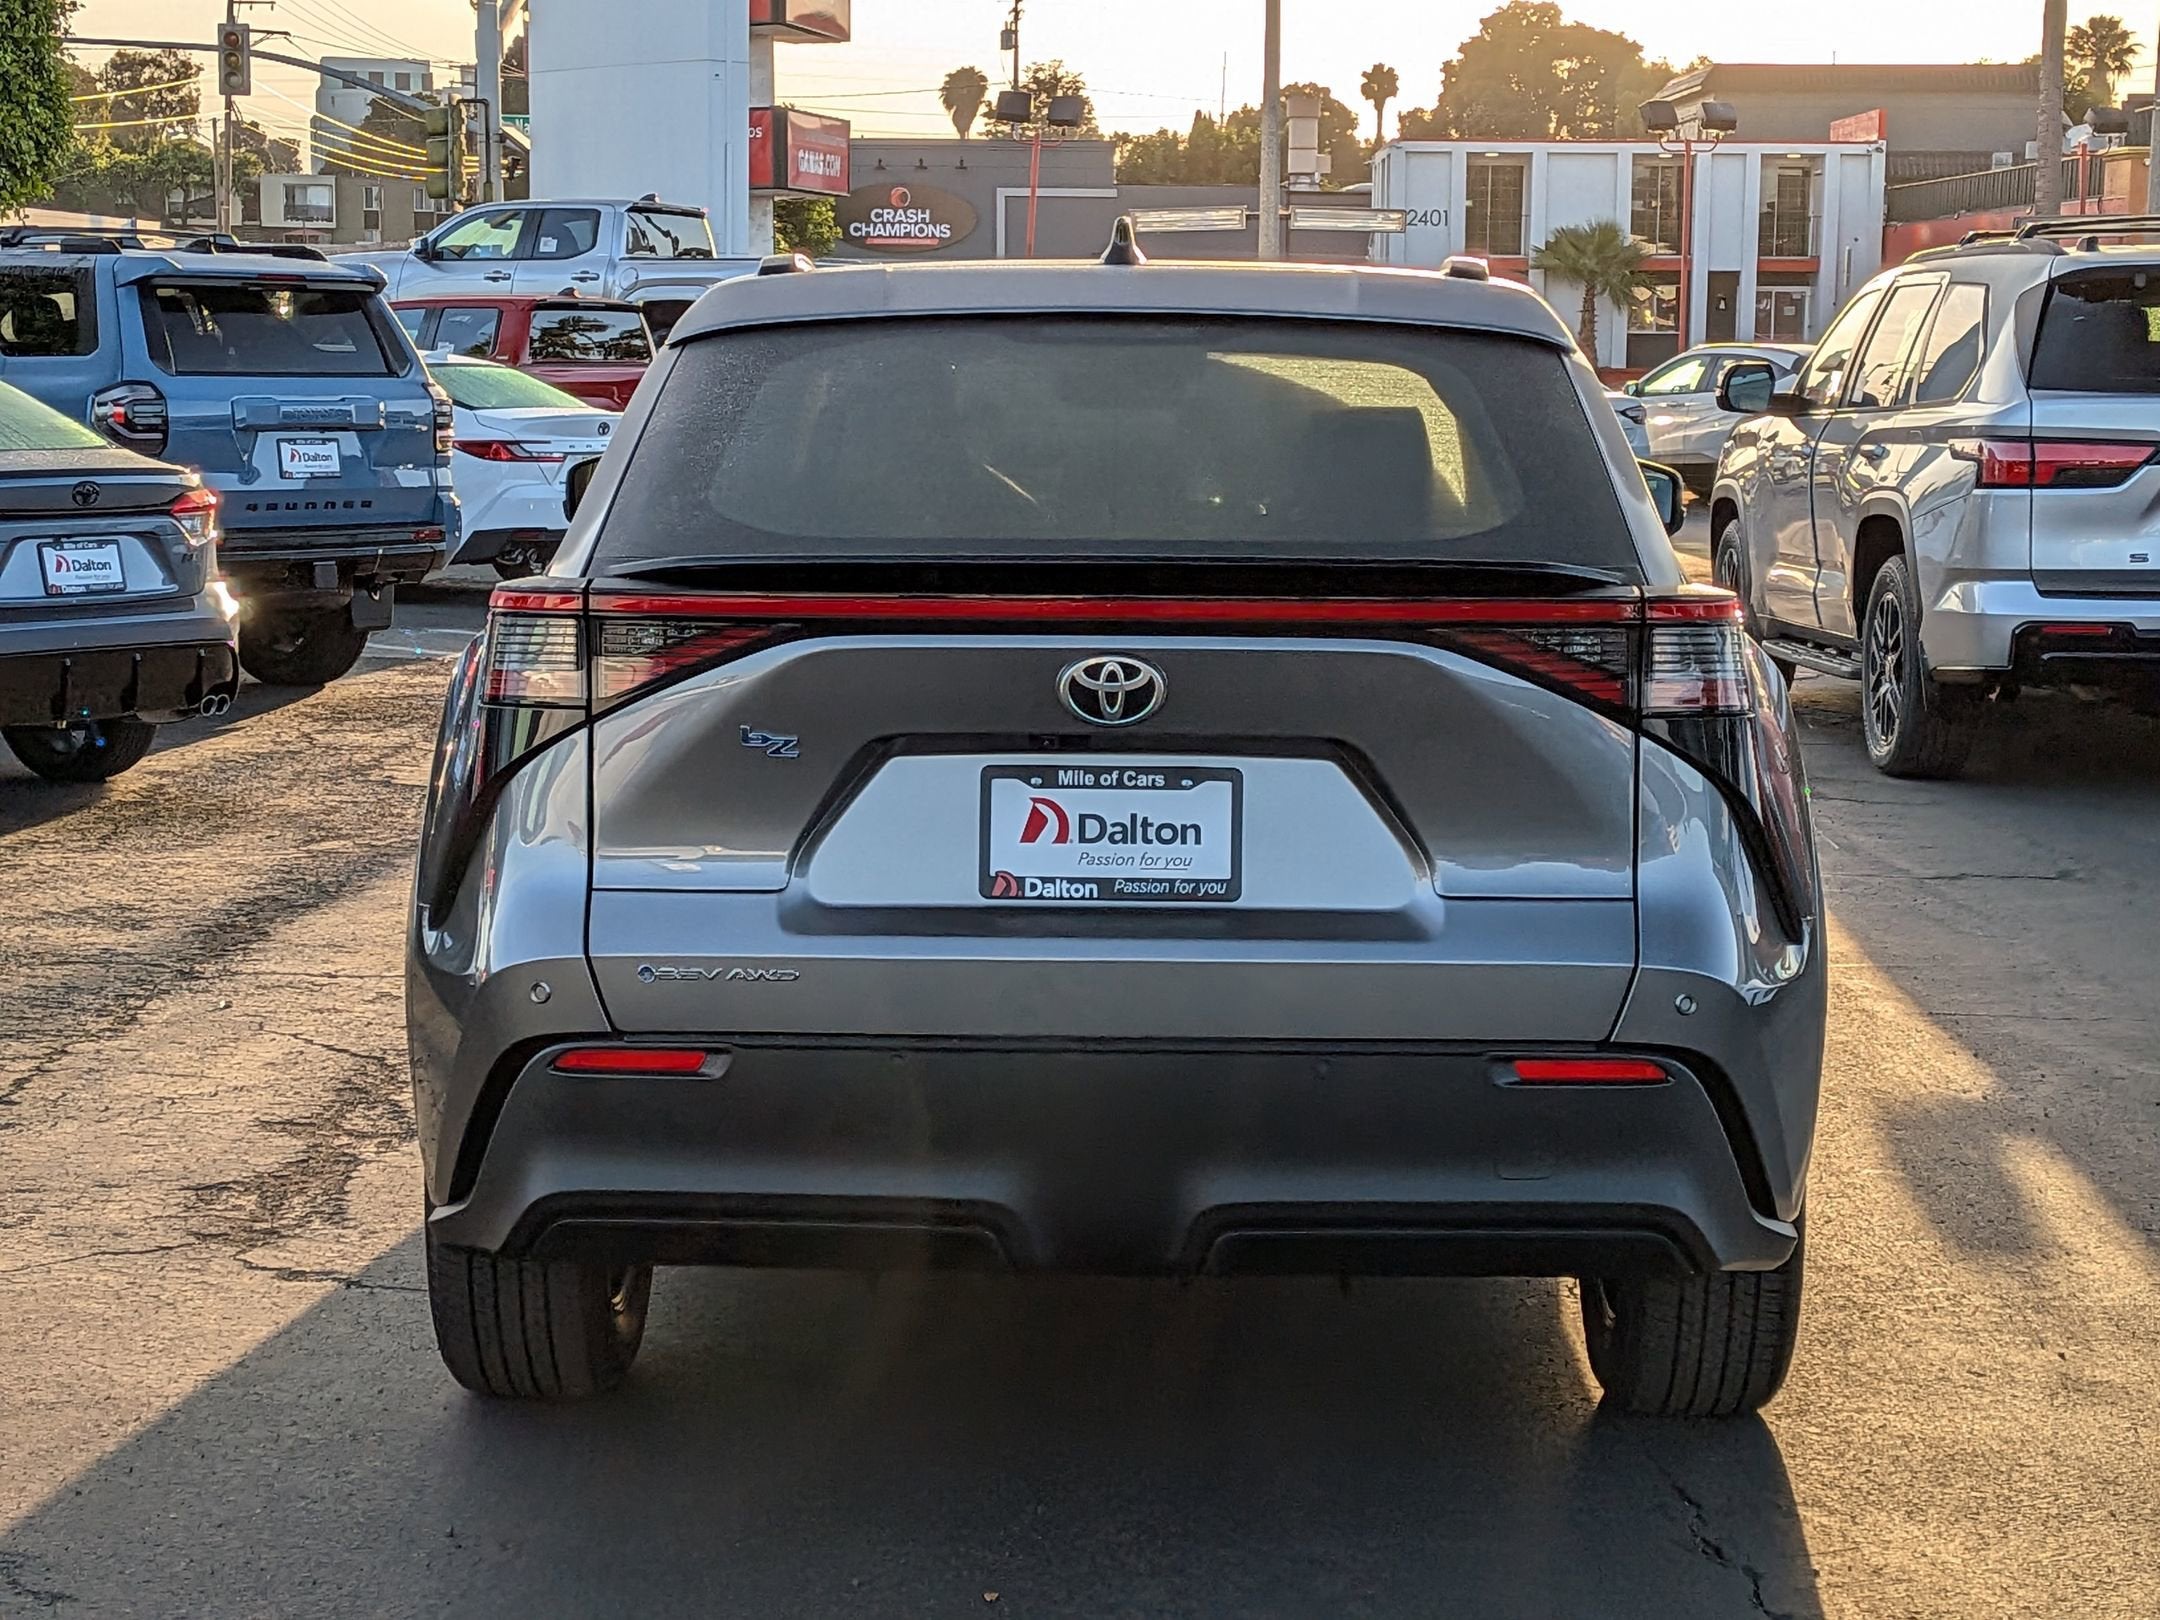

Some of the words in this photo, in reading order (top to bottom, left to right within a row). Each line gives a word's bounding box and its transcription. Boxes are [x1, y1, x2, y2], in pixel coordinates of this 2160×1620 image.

[870, 208, 931, 223] CRASH
[1407, 208, 1448, 227] 2401
[849, 222, 951, 239] CHAMPIONS
[302, 452, 333, 462] Dalton
[71, 558, 112, 572] Dalton
[1058, 769, 1095, 786] Mile
[1100, 769, 1119, 786] of
[1123, 770, 1166, 787] Cars
[1078, 812, 1202, 846] Dalton
[1077, 851, 1135, 867] Passion
[1138, 851, 1161, 868] for
[1164, 856, 1193, 869] you
[1024, 877, 1099, 898] Dalton
[1114, 878, 1169, 894] Passion
[1173, 879, 1196, 895] for
[1197, 881, 1227, 897] you
[657, 966, 723, 981] BEV
[725, 967, 800, 982] AWD
